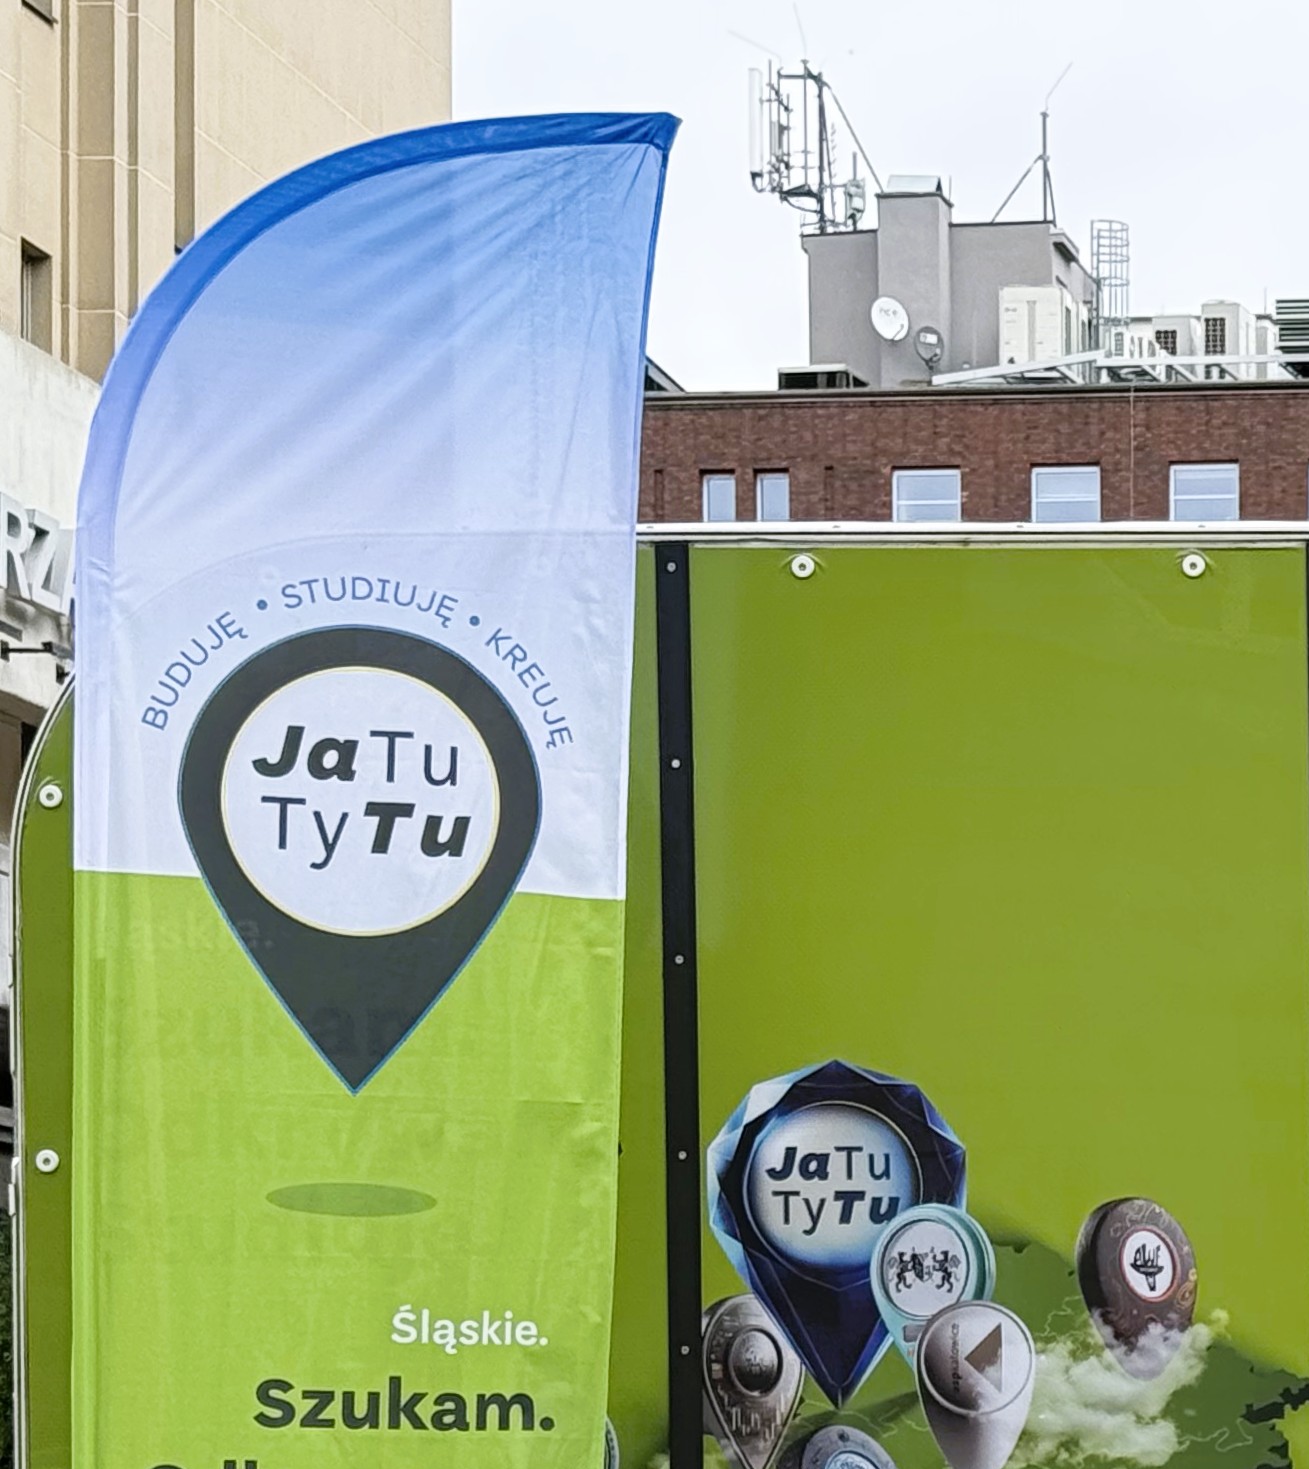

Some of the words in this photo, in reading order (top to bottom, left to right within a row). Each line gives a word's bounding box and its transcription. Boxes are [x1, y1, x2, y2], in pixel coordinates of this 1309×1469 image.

[0, 487, 76, 617] RZ
[141, 610, 248, 731] BUDUJĘ
[280, 576, 459, 629] STUDIUJĘ
[484, 627, 575, 750] KREUJĘ
[390, 1305, 549, 1355] Śląskie.
[253, 1375, 556, 1432] Szukam.
